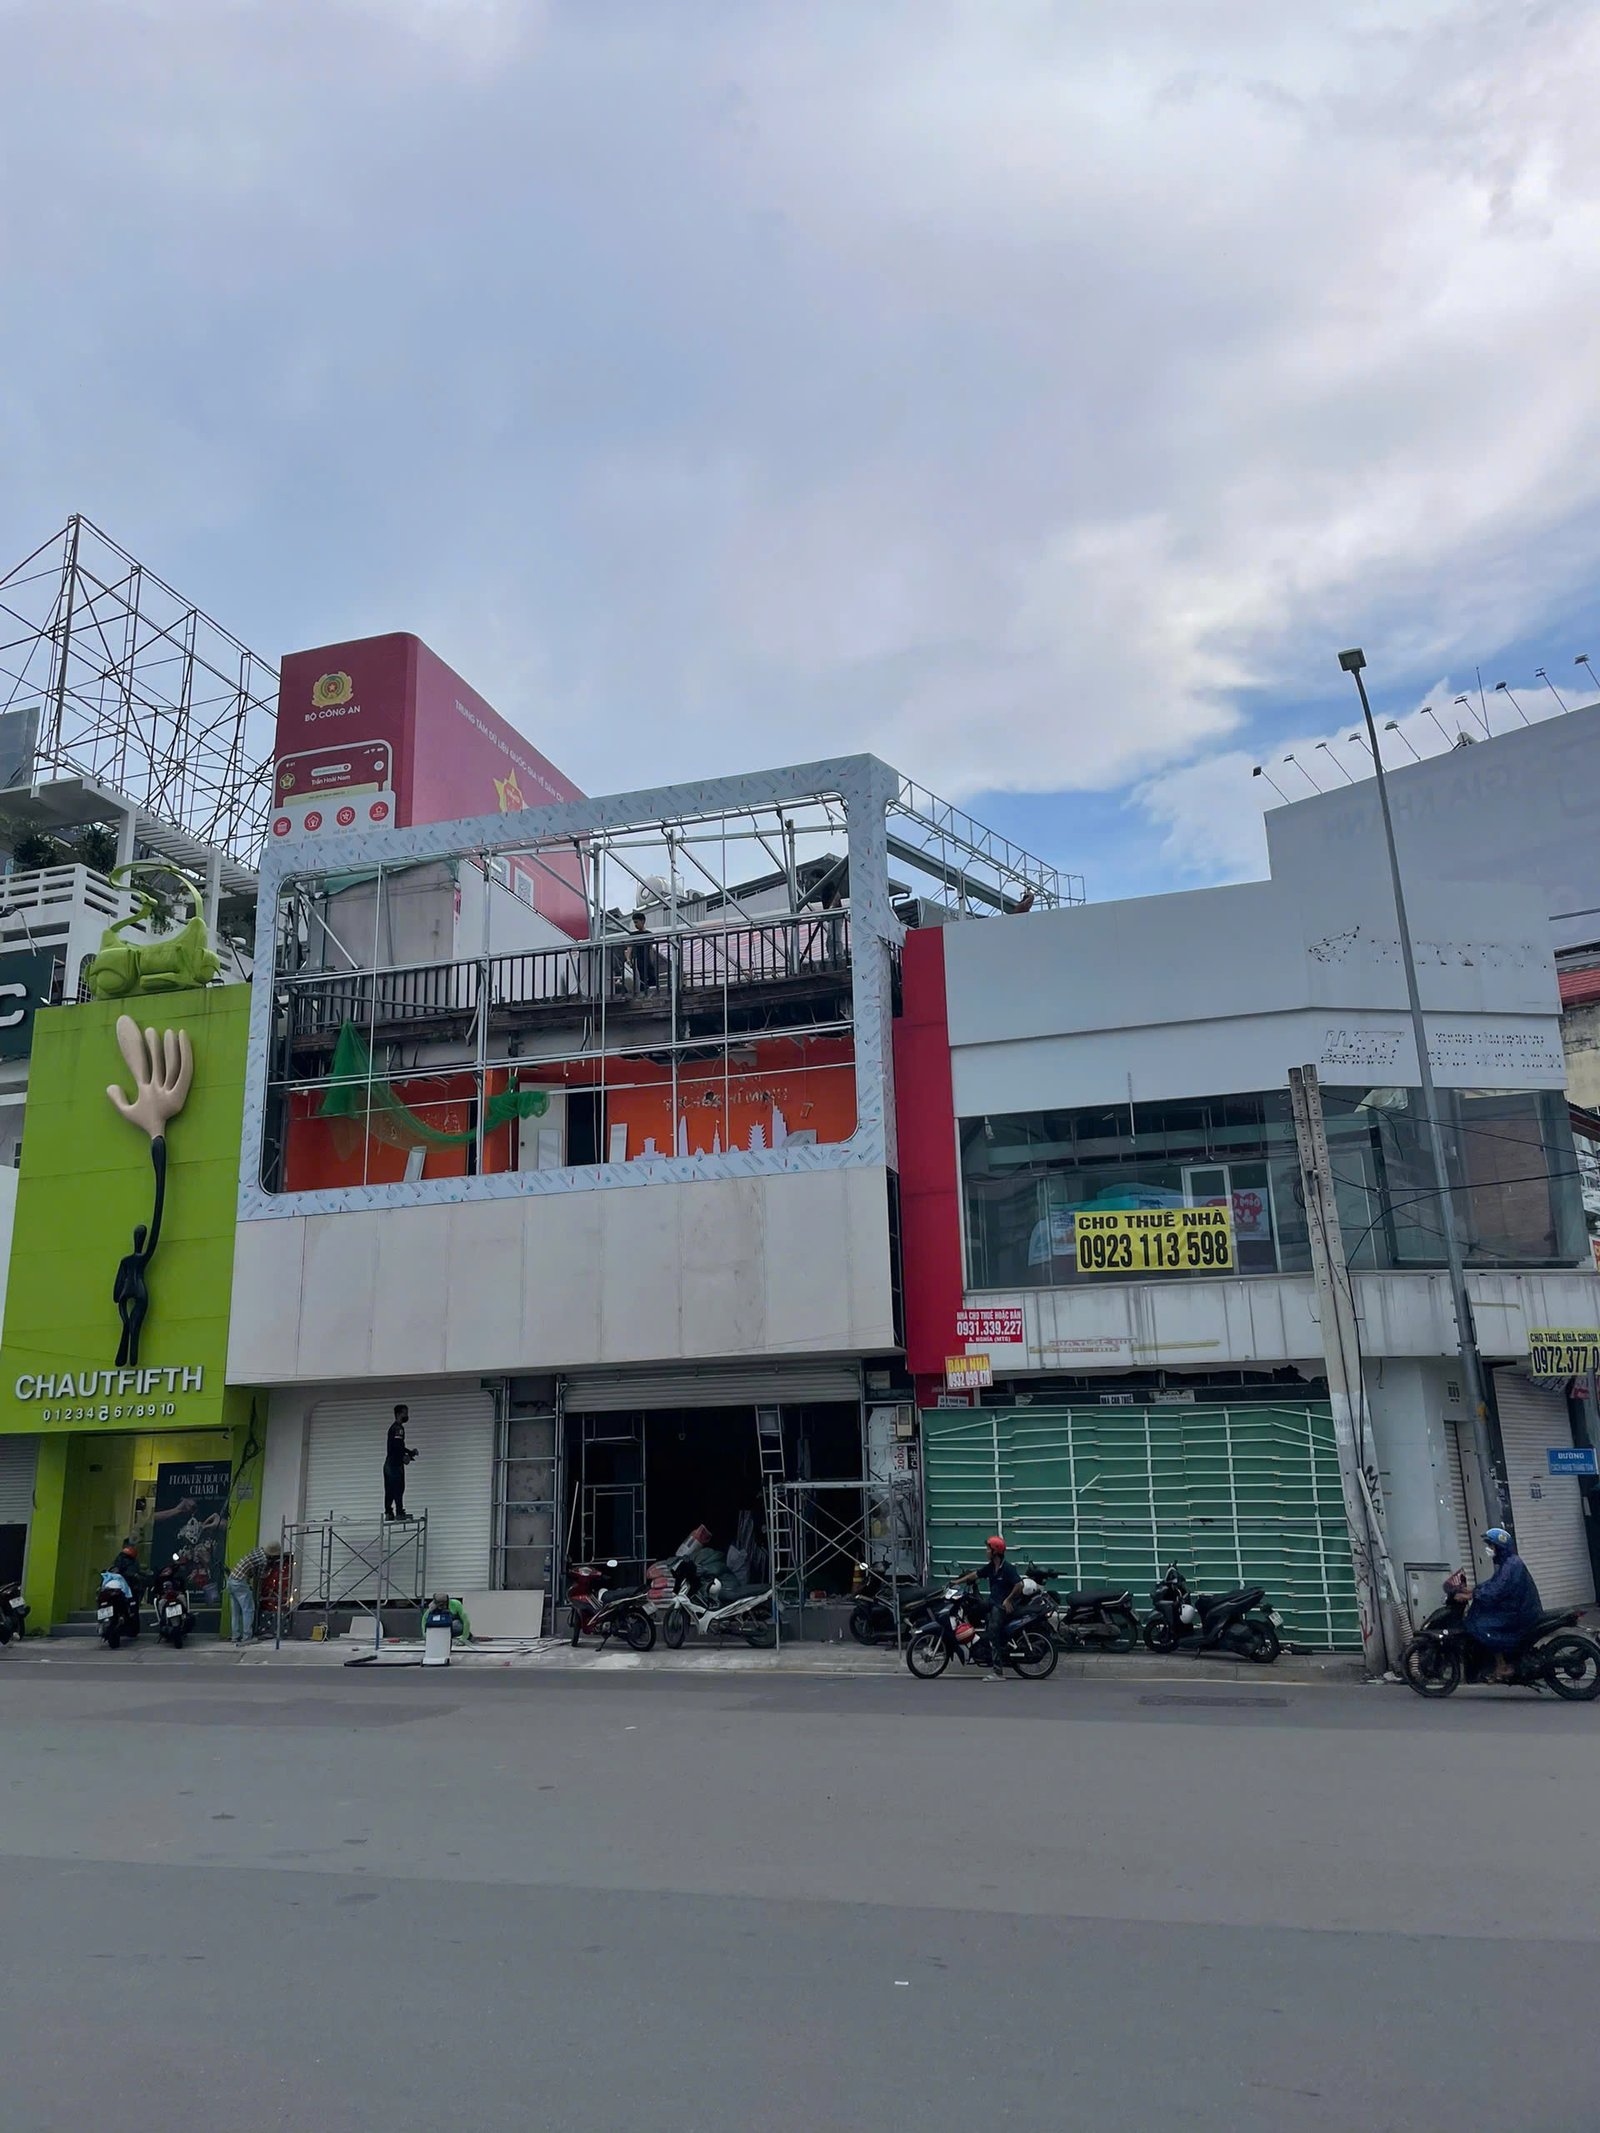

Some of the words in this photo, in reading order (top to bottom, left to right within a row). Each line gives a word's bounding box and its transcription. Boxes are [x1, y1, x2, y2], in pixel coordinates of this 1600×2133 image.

[304, 712, 317, 723] BỘ
[318, 707, 346, 720] CÔNG
[347, 705, 361, 715] AN
[1078, 1216, 1118, 1230] CHO
[1124, 1211, 1175, 1229] THUÊ
[1182, 1208, 1226, 1226] NHÀ
[1080, 1233, 1133, 1269] 0923
[1139, 1233, 1180, 1267] 113
[1187, 1230, 1229, 1265] 598
[957, 1320, 1022, 1335] 0931.339.227
[1530, 1332, 1543, 1343] CHO
[1544, 1331, 1561, 1343] THUÊ
[1562, 1330, 1577, 1342] NHÀ
[1533, 1346, 1588, 1374] 0972.377
[15, 1366, 203, 1400] CHAUTFIFTH
[169, 1474, 202, 1485] FLOWER
